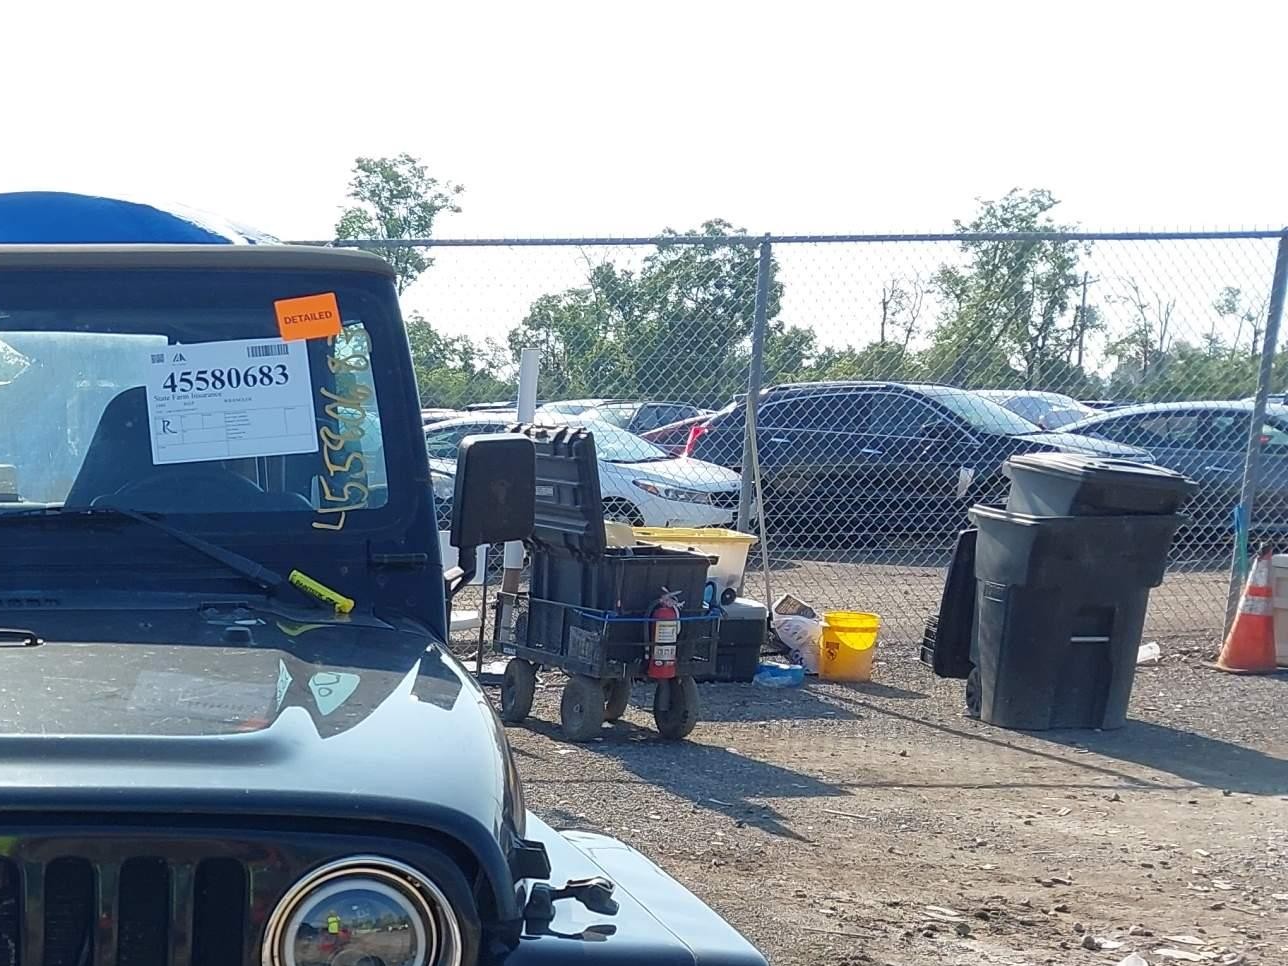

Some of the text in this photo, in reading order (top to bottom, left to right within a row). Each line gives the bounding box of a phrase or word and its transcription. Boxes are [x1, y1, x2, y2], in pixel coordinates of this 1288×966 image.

[283, 310, 333, 325] DETAILED
[163, 364, 290, 393] 45580683
[153, 391, 222, 402] State Farm Insurance
[161, 419, 177, 434] R
